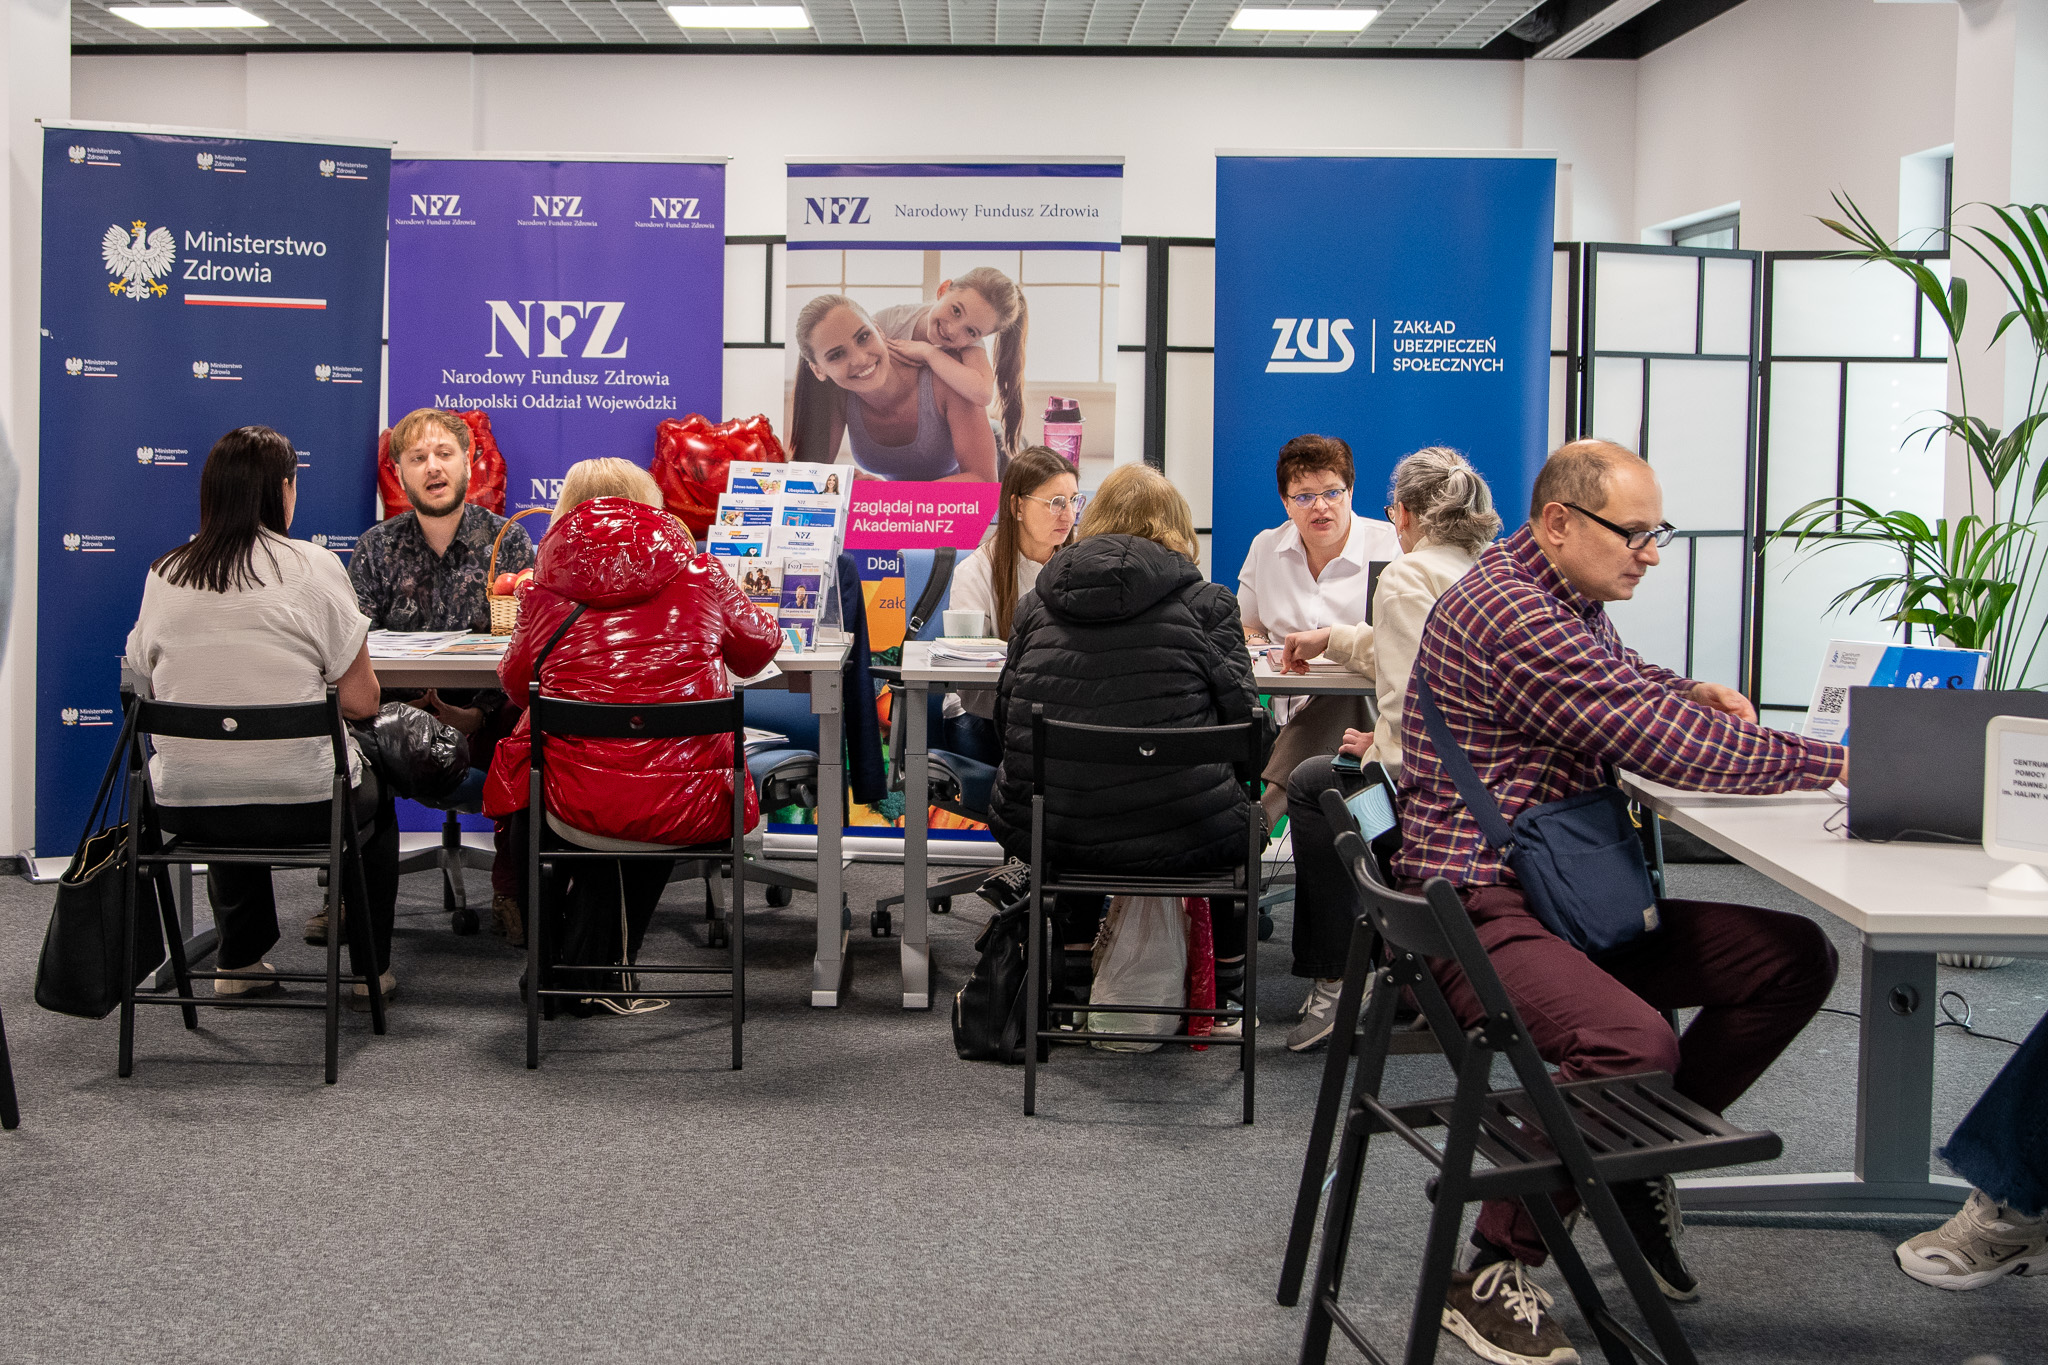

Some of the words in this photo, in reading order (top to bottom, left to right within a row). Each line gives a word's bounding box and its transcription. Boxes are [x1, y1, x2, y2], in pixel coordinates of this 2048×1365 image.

[87, 148, 121, 156] Ministerstwo
[215, 155, 246, 163] Ministerstwo
[337, 162, 368, 170] Ministerstwo
[411, 195, 461, 215] NFZ
[533, 196, 582, 216] NFZ
[651, 198, 700, 218] NFZ
[804, 197, 870, 224] NFZ
[894, 203, 968, 221] Narodowy
[976, 204, 1033, 217] Fundusz
[1040, 204, 1098, 217] Zdrowia
[185, 231, 326, 256] Ministerstwo
[183, 259, 271, 282] Zdrowia
[485, 301, 628, 358] NFZ
[1394, 321, 1455, 333] ZAKŁAD
[1265, 318, 1355, 373] ZUS
[1394, 337, 1495, 352] UBEZPIECZEŃ
[1393, 358, 1503, 371] SPOŁECZNYCH
[442, 369, 525, 386] Narodowy
[532, 369, 598, 384] Fundusz
[605, 370, 669, 385] Zdrowia
[434, 394, 518, 411] Małopolski
[522, 394, 582, 408] Oddział
[586, 396, 676, 413] Wojewódzki
[530, 478, 566, 500] NF
[853, 500, 912, 516] zaglądaj
[917, 503, 933, 513] na
[938, 501, 979, 516] portal
[853, 519, 953, 532] AkademiaNFZ
[795, 531, 811, 540] NFZ
[868, 557, 899, 573] Dbaj
[2013, 758, 2048, 768] CENTRUM
[2015, 769, 2046, 778] POMOCY
[2012, 779, 2048, 789] PRAWNEJ
[2014, 790, 2041, 799] HALINY
